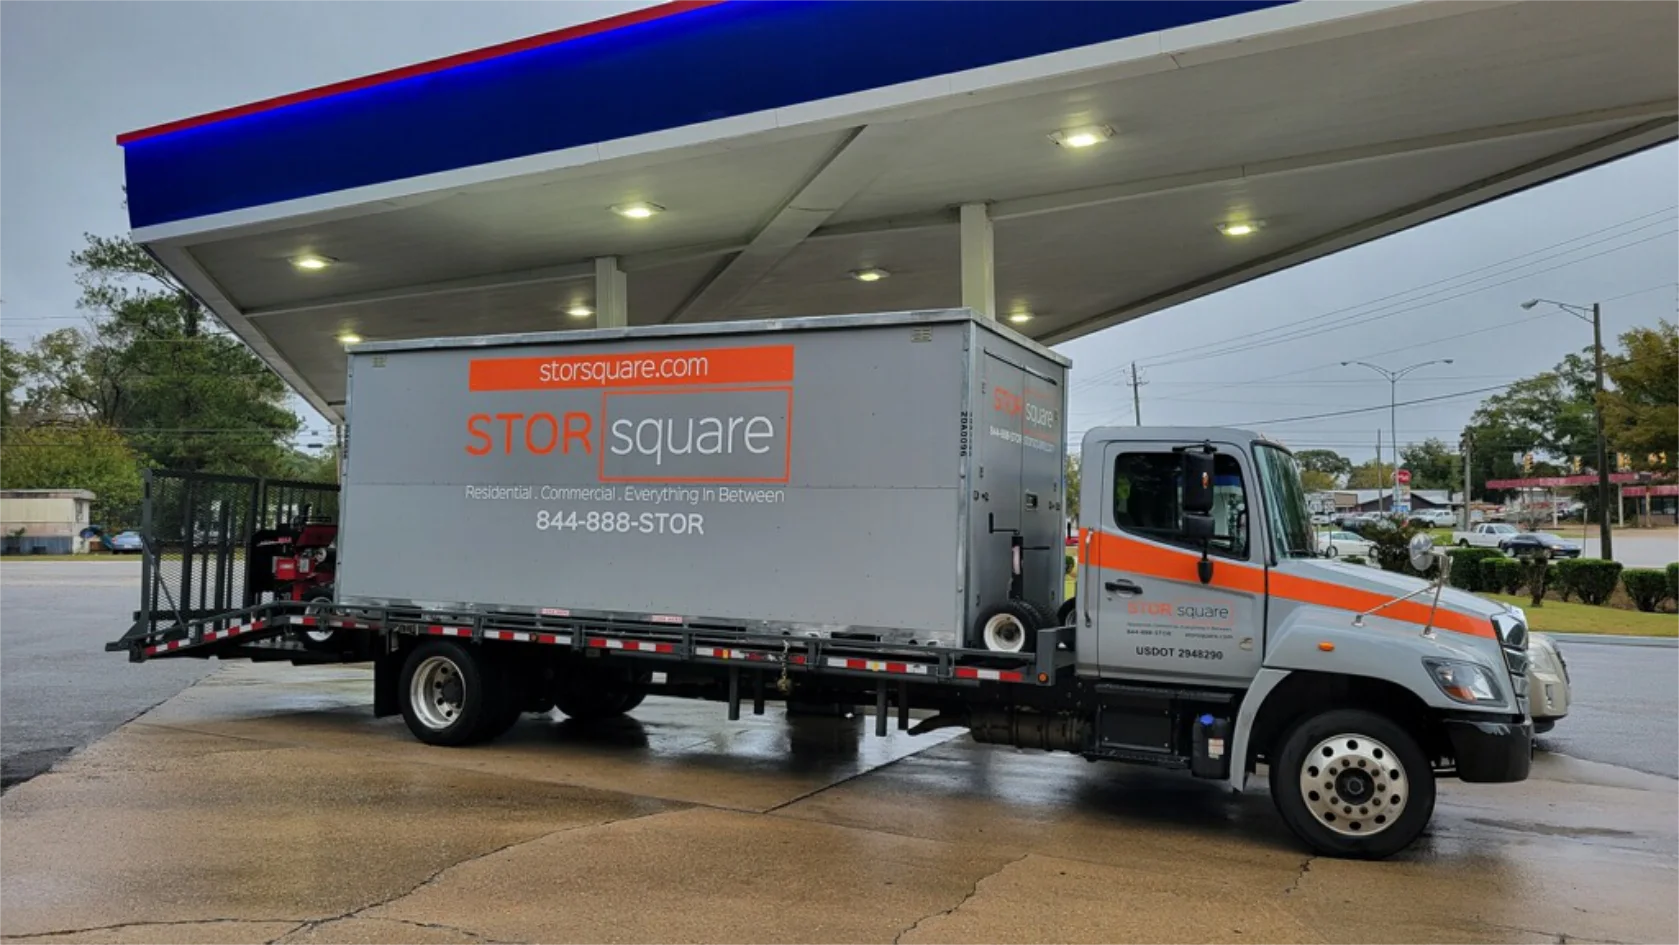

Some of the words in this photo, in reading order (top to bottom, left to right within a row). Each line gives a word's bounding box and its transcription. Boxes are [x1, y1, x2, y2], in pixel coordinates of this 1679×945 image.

[539, 354, 709, 385] storsquare.com
[1025, 402, 1054, 429] square
[465, 410, 593, 457] STOR
[610, 414, 775, 466] square
[465, 485, 532, 500] Residential
[540, 485, 616, 501] Commercial
[624, 486, 699, 505] Everything
[702, 487, 715, 502] In
[719, 487, 785, 503] Between
[535, 509, 705, 535] 844-888-STOR
[1127, 600, 1172, 616] STOR
[1177, 605, 1229, 619] square
[1135, 646, 1175, 658] USDOT
[1178, 648, 1224, 660] 2948290
